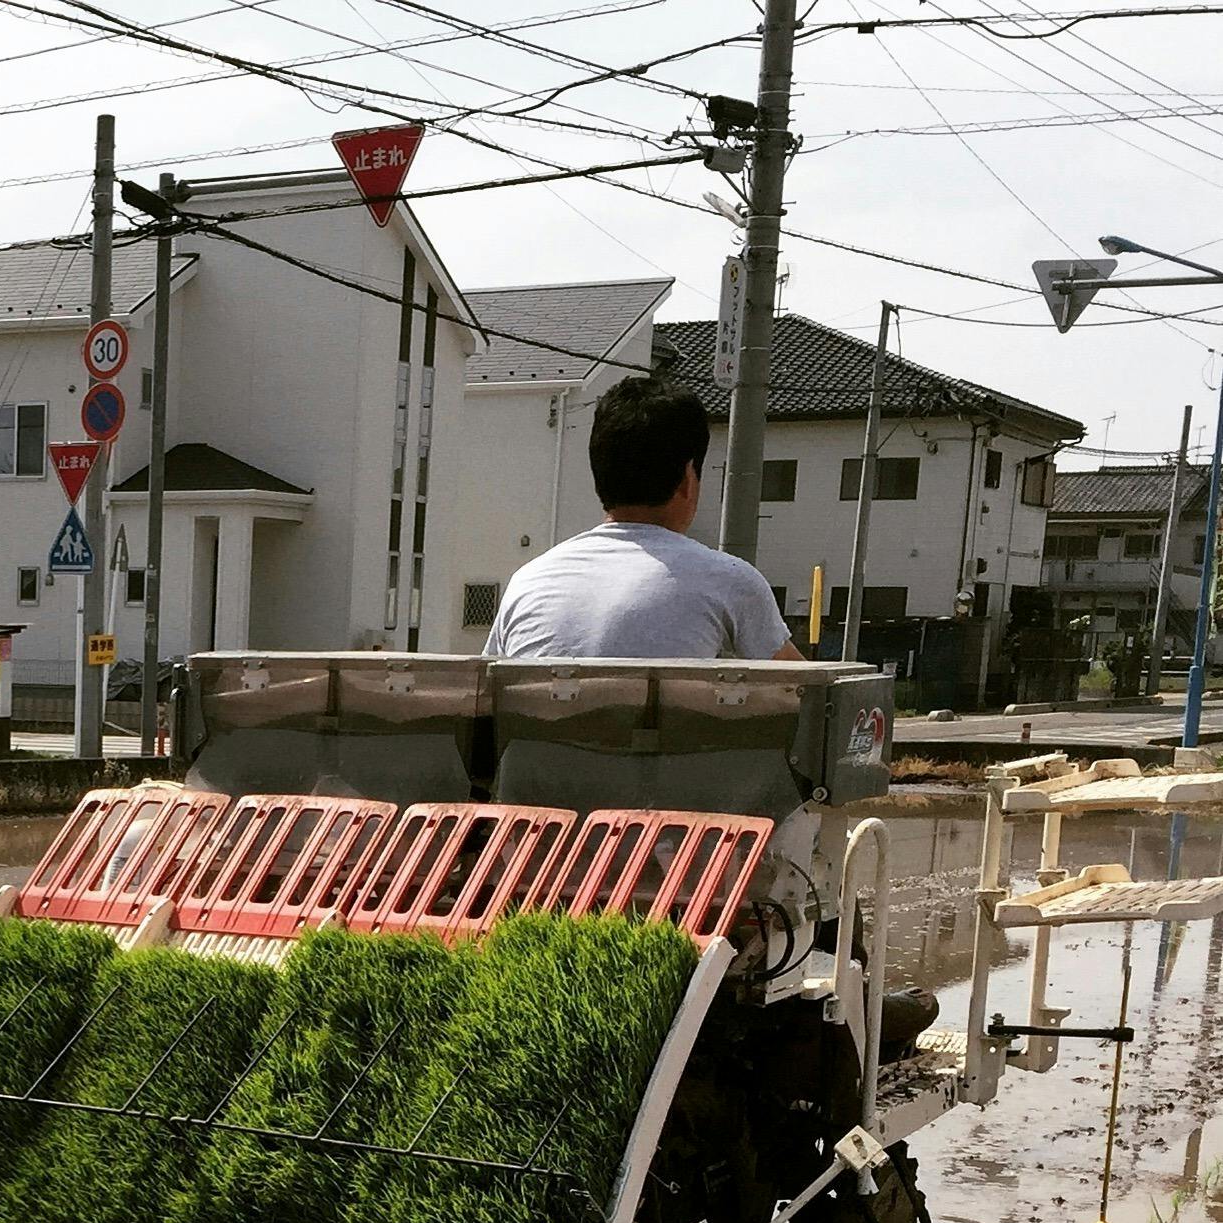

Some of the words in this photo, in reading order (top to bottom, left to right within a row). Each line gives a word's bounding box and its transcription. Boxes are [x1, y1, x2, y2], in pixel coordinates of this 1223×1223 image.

[353, 144, 408, 172] 止まれ
[93, 337, 119, 363] 30
[58, 455, 91, 470] 止まれ
